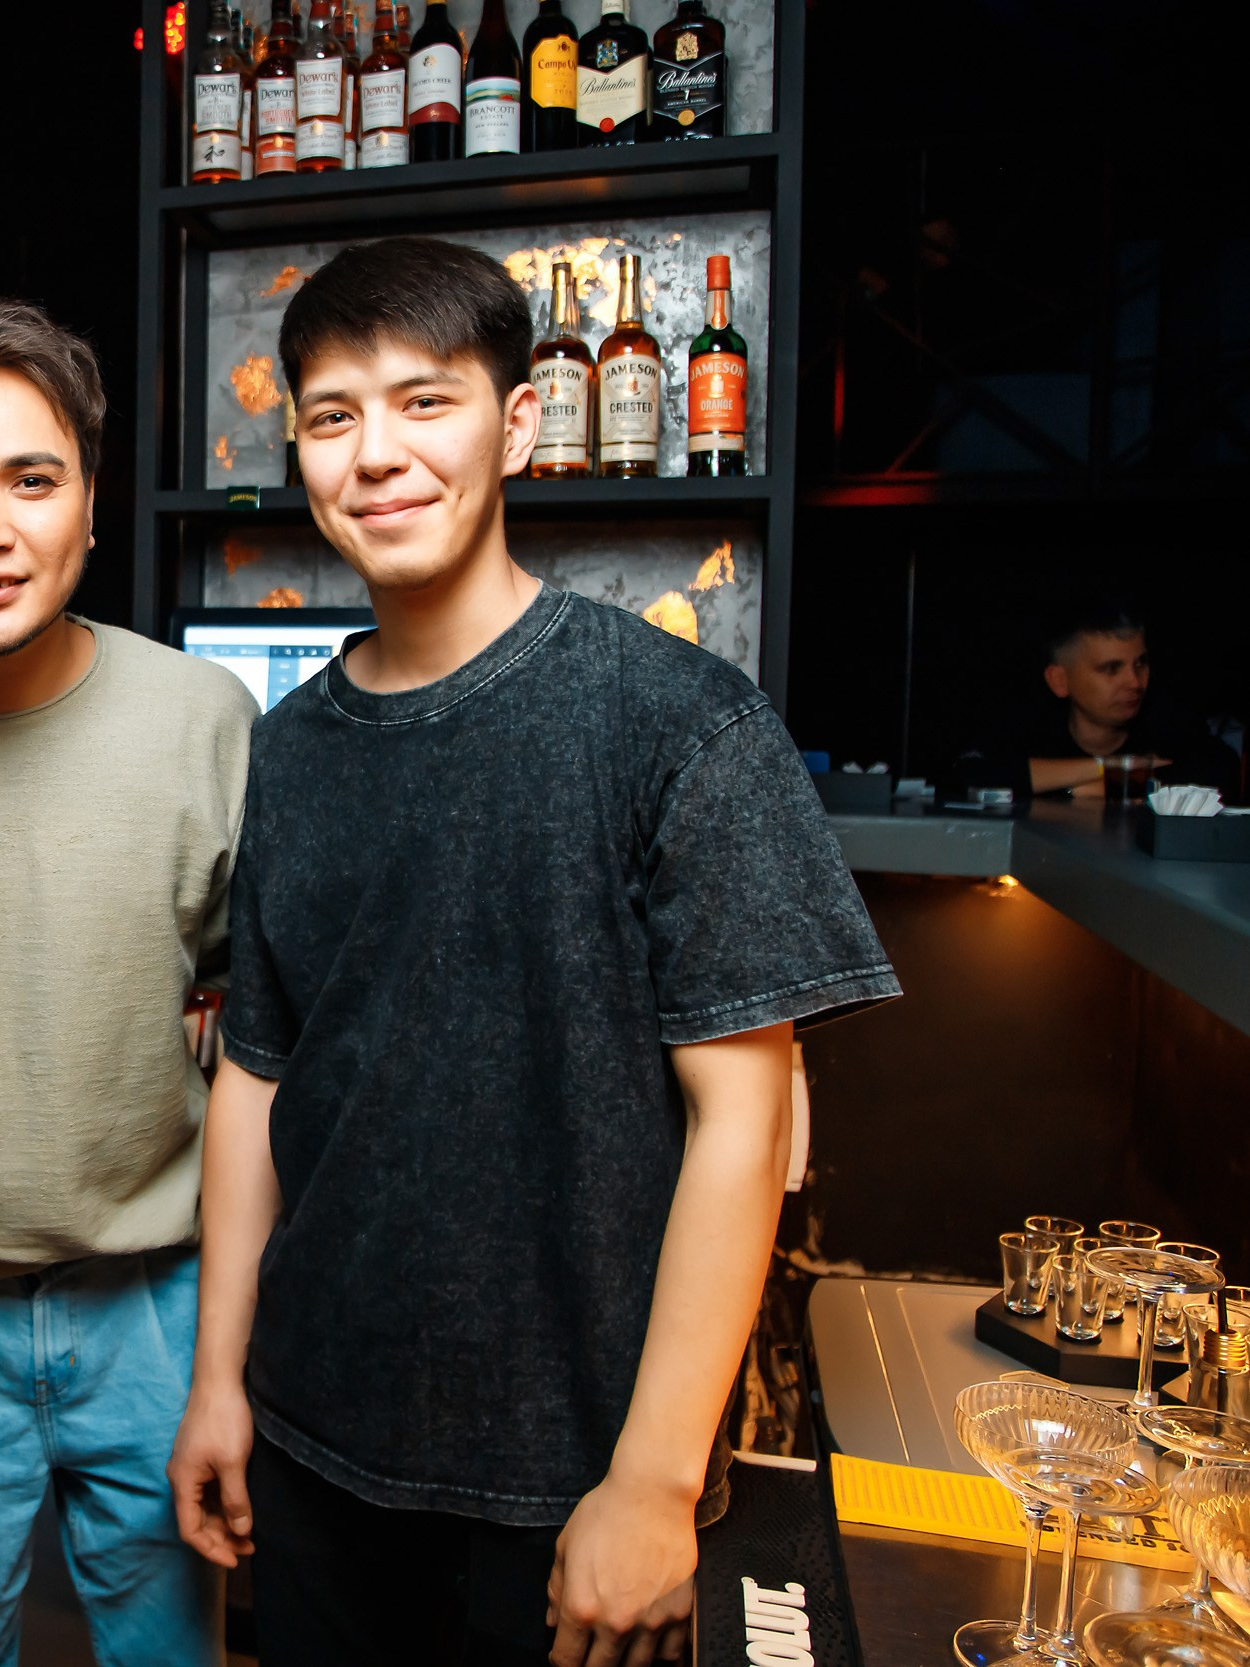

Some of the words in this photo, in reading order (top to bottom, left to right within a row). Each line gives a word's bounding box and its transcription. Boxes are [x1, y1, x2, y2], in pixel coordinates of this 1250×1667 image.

[538, 59, 567, 72] Campo
[299, 72, 339, 86] Dewar's
[658, 71, 717, 90] Ballantine's
[198, 83, 238, 96] Dewar's
[363, 83, 402, 99] Dewar's
[580, 78, 637, 96] Ballantine's
[684, 89, 690, 100] 7
[470, 105, 516, 118] BRANCOTT
[533, 368, 582, 383] JAMESON
[605, 363, 658, 381] JAMESON
[690, 361, 745, 382] JAMESON
[542, 405, 577, 416] RESTED
[610, 402, 653, 414] CRESTED
[701, 399, 733, 411] ORANGE
